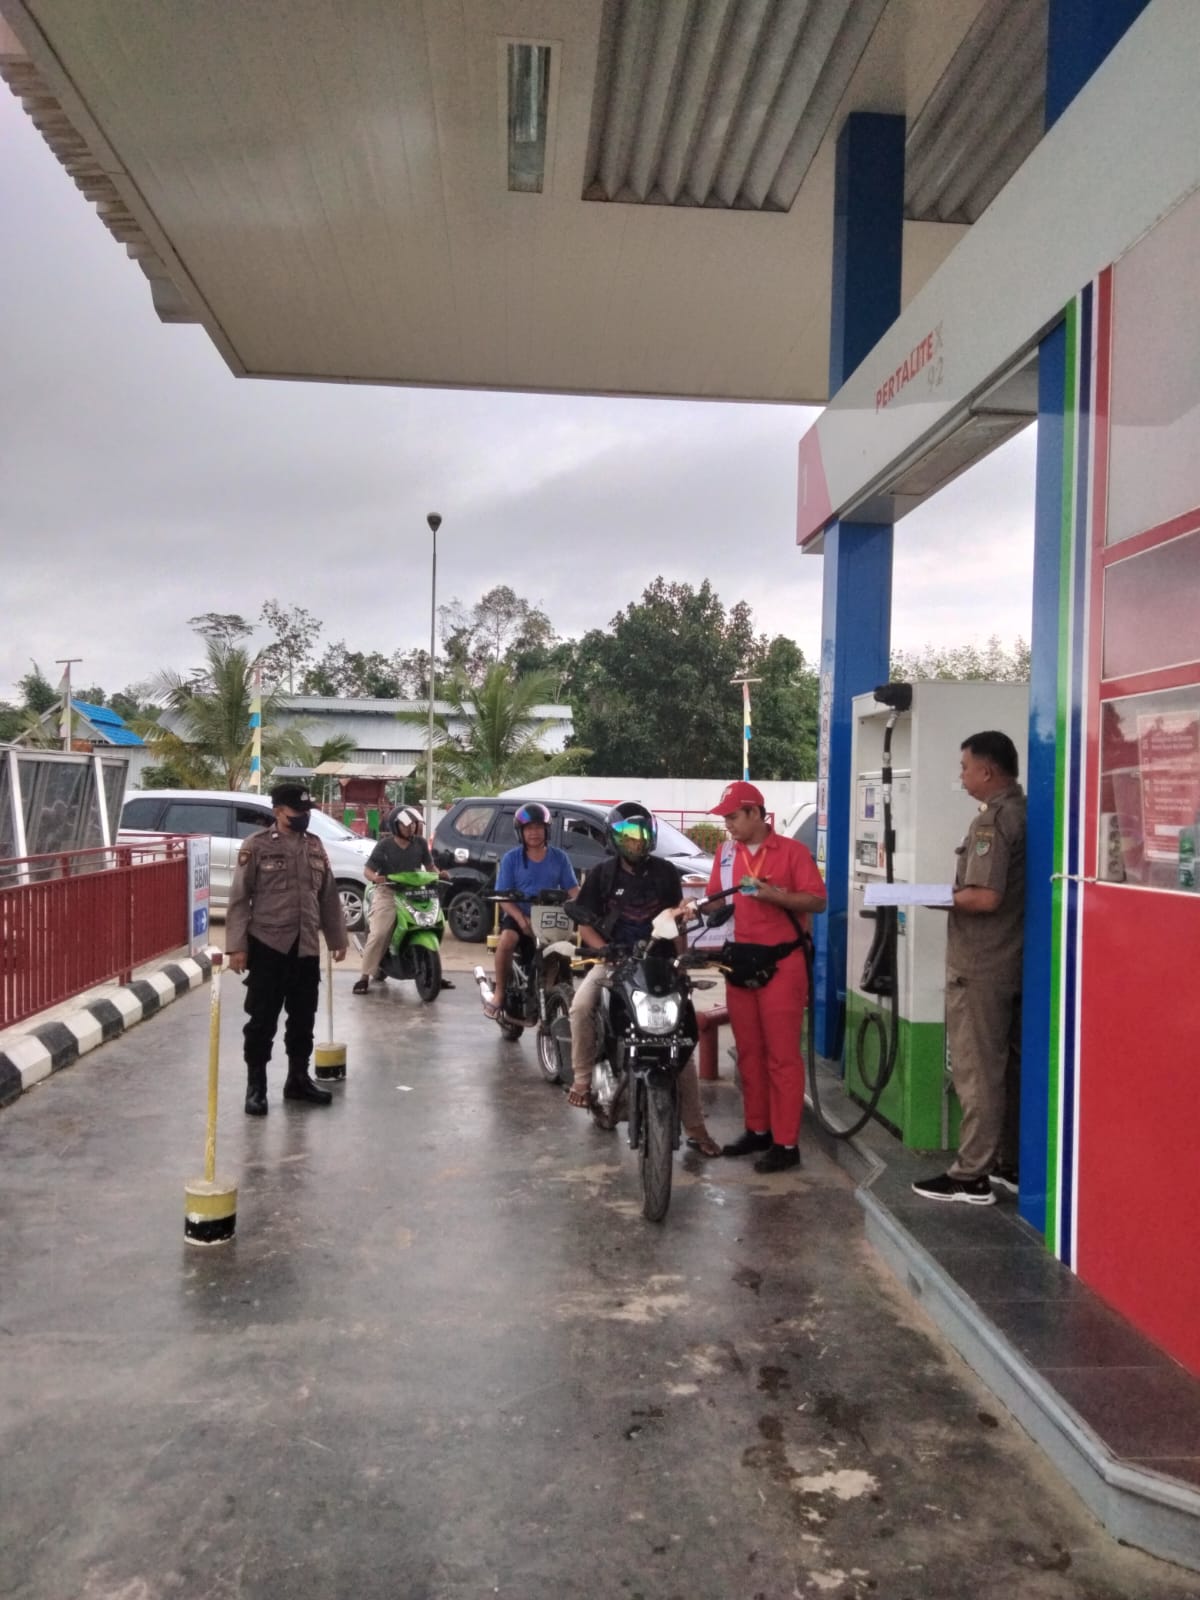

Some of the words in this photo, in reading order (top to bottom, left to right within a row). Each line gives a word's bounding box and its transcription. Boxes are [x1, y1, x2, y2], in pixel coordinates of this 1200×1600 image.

[876, 330, 933, 414] PERTALITE
[928, 356, 944, 392] 92
[194, 867, 209, 889] BBM
